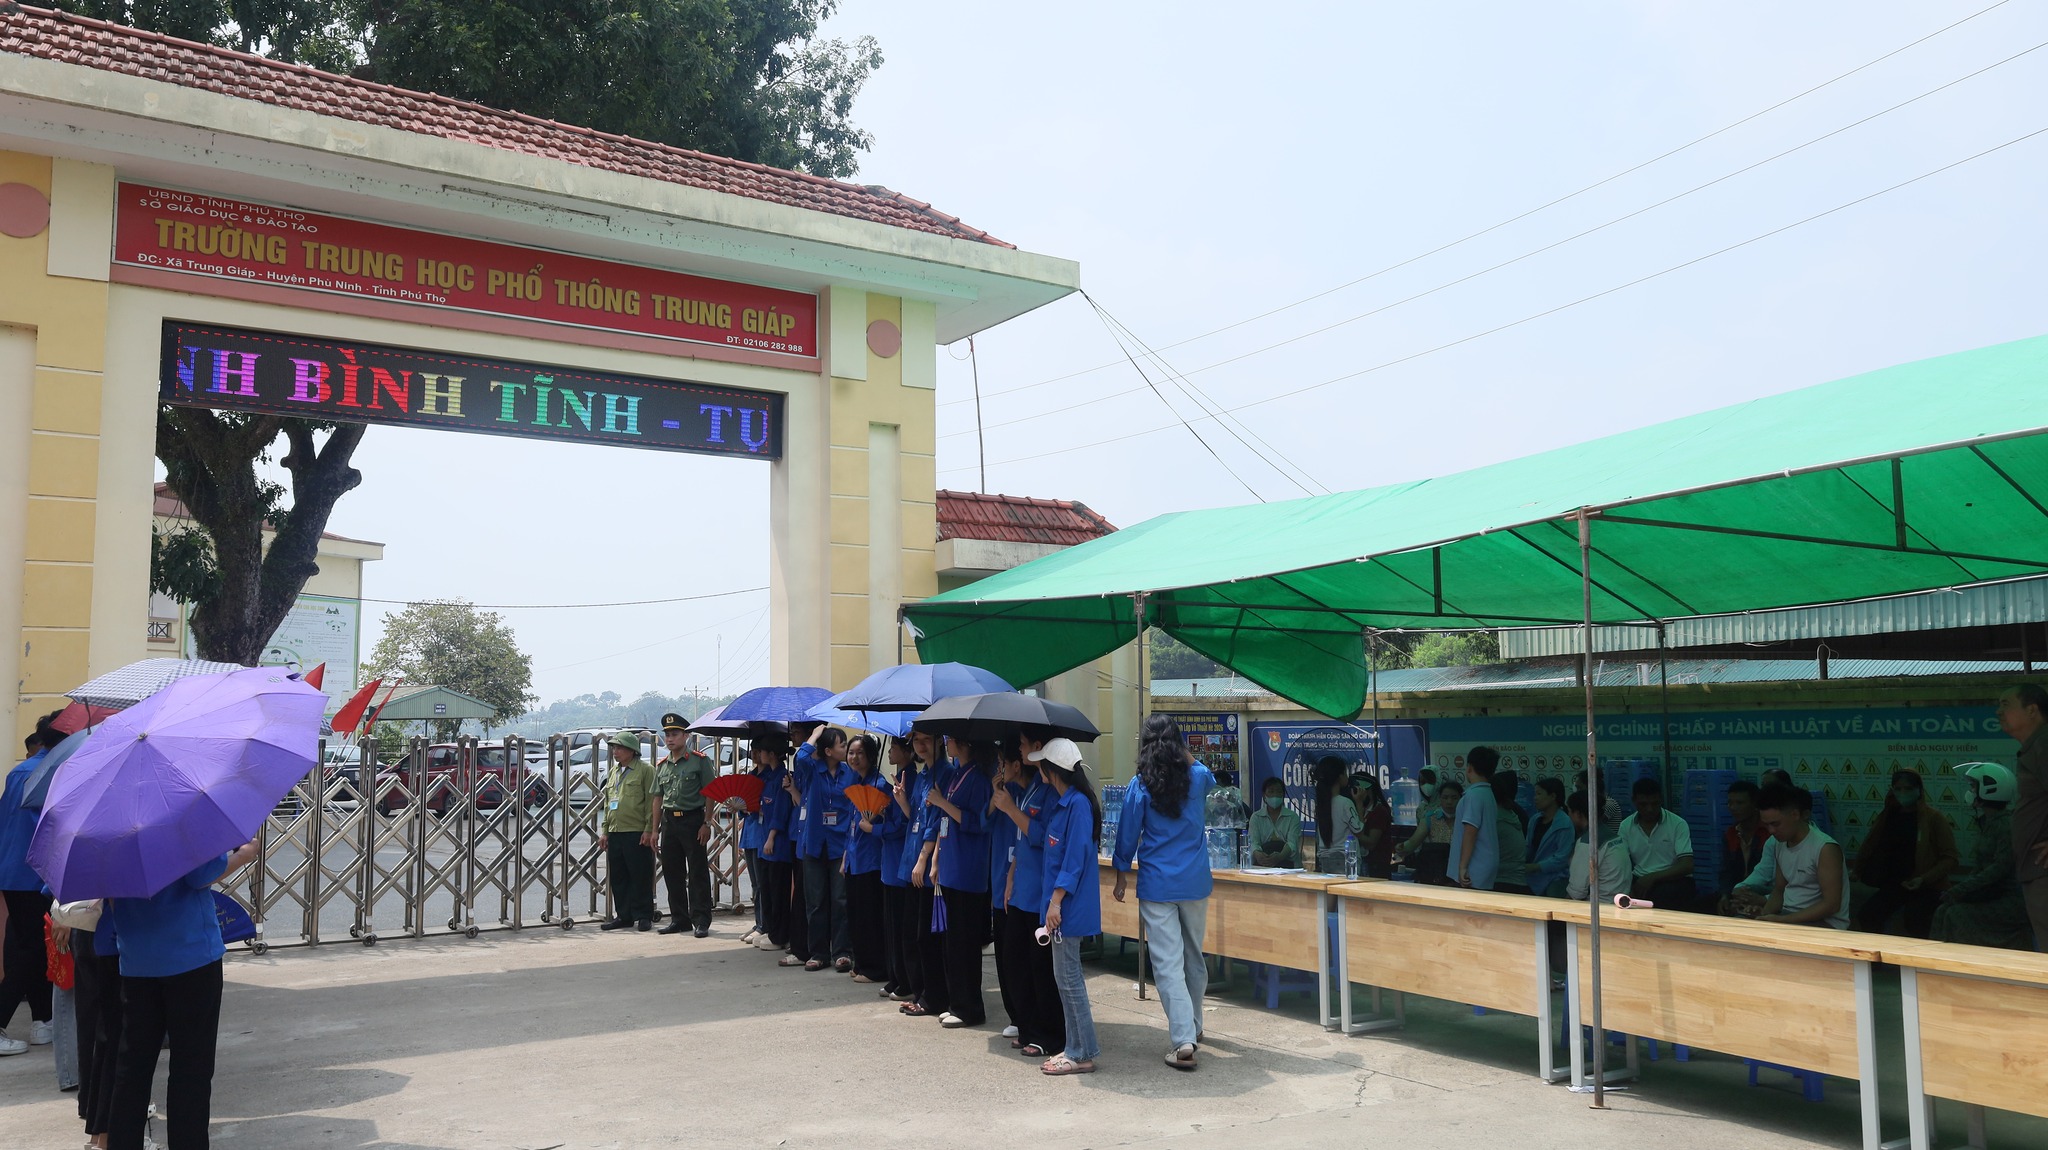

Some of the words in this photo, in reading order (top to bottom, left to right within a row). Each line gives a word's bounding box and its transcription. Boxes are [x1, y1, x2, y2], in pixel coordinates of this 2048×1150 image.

[148, 190, 194, 202] UBND
[239, 204, 270, 215] PHÚ
[274, 210, 305, 222] THỌ
[210, 210, 239, 221] DỤC
[256, 216, 288, 228] ĐÀO
[292, 222, 318, 233] TẠO
[138, 253, 162, 264] ĐC:
[166, 258, 182, 267] Xã
[186, 260, 223, 274] Trung
[227, 266, 256, 278] Giáp
[268, 271, 304, 285] Huyện
[309, 276, 332, 287] Phù
[336, 280, 362, 291] Ninh
[372, 285, 397, 296] Tỉnh
[400, 290, 422, 300] Phú
[425, 293, 446, 304] Thọ
[155, 218, 286, 265] TRƯỜNG
[302, 240, 403, 282] TRUNG
[417, 258, 475, 294] HỌC
[488, 264, 544, 301] PHỔ
[554, 278, 640, 316] THÔNG
[652, 294, 732, 329] TRUNG
[742, 306, 796, 337] GIÁP
[726, 336, 740, 344] ĐT:
[744, 338, 768, 348] 02106
[771, 342, 786, 350] 282
[788, 344, 802, 352] 988
[287, 348, 467, 418] BÌNH
[490, 374, 642, 435] TĨNH
[662, 420, 680, 429] -
[1608, 720, 1661, 736] CHỈNH
[1668, 718, 1716, 735] CHẤP
[1722, 718, 1774, 734] HÀNH
[1782, 718, 1830, 737] LUẬT
[1836, 715, 1864, 733] VỀ
[1870, 719, 1901, 733] AN
[1907, 716, 1975, 732] TOÀN
